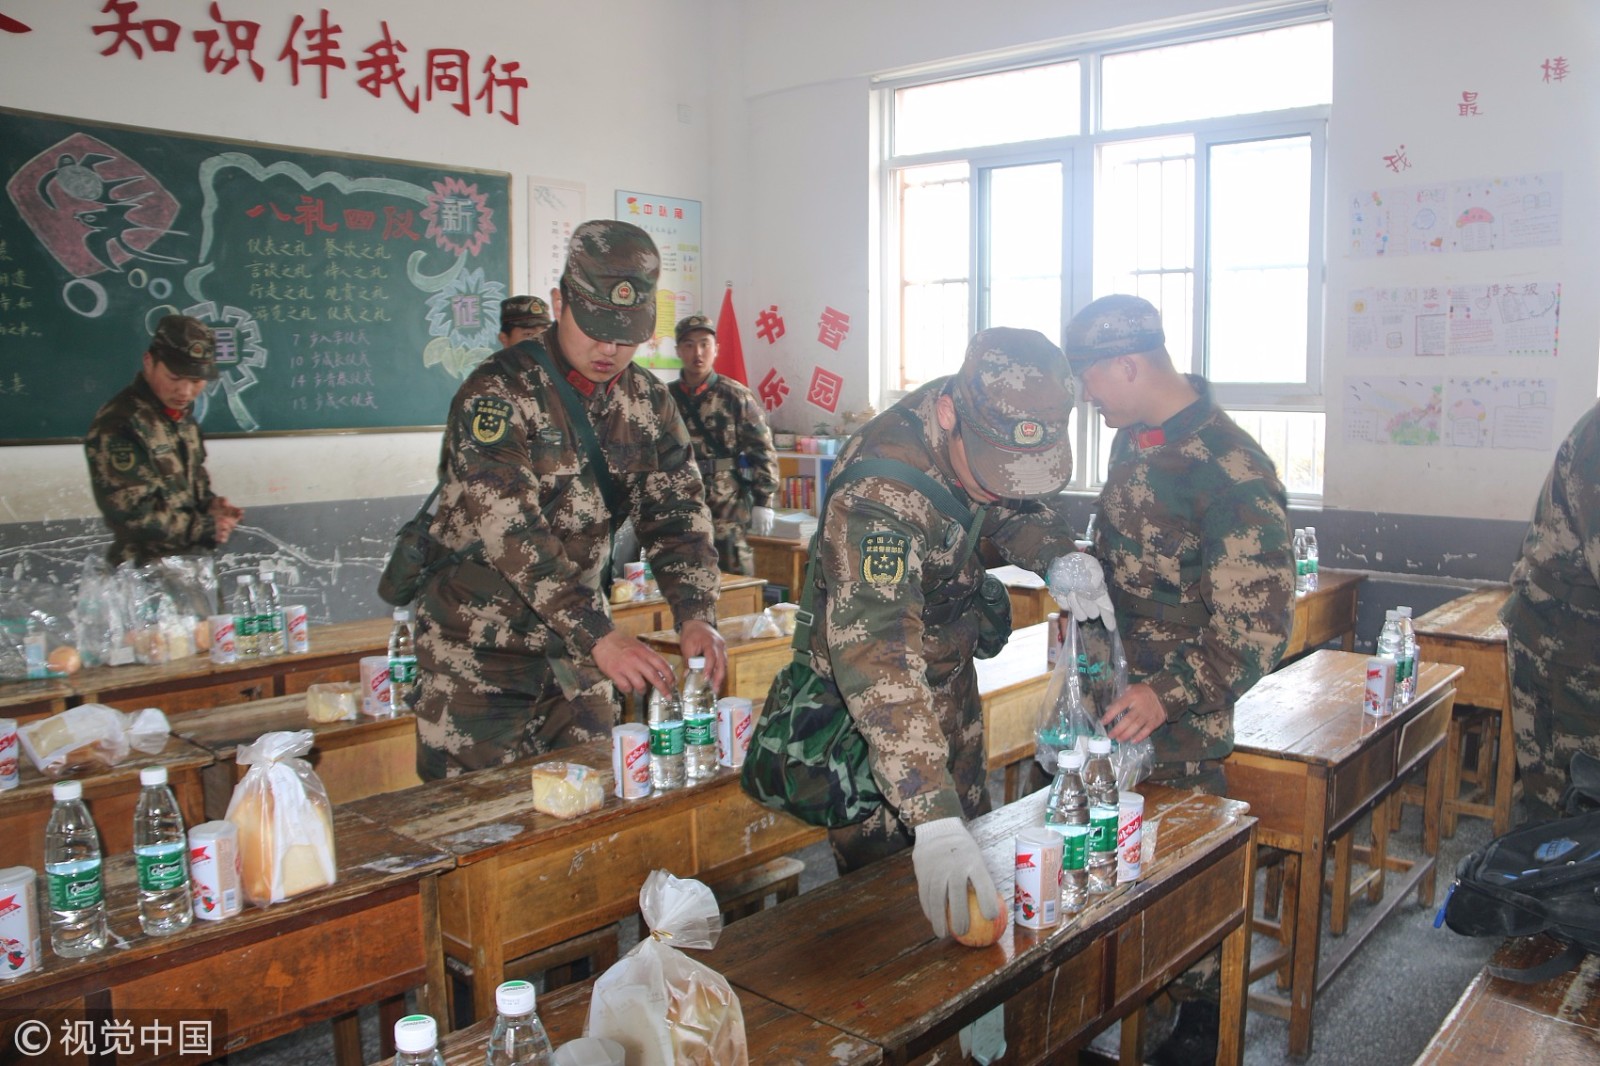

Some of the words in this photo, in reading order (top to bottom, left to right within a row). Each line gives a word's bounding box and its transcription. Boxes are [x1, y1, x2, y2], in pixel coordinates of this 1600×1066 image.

[92, 0, 528, 125] 知识伴我同行
[246, 196, 420, 240] 八礼四仪
[441, 196, 473, 232] 新
